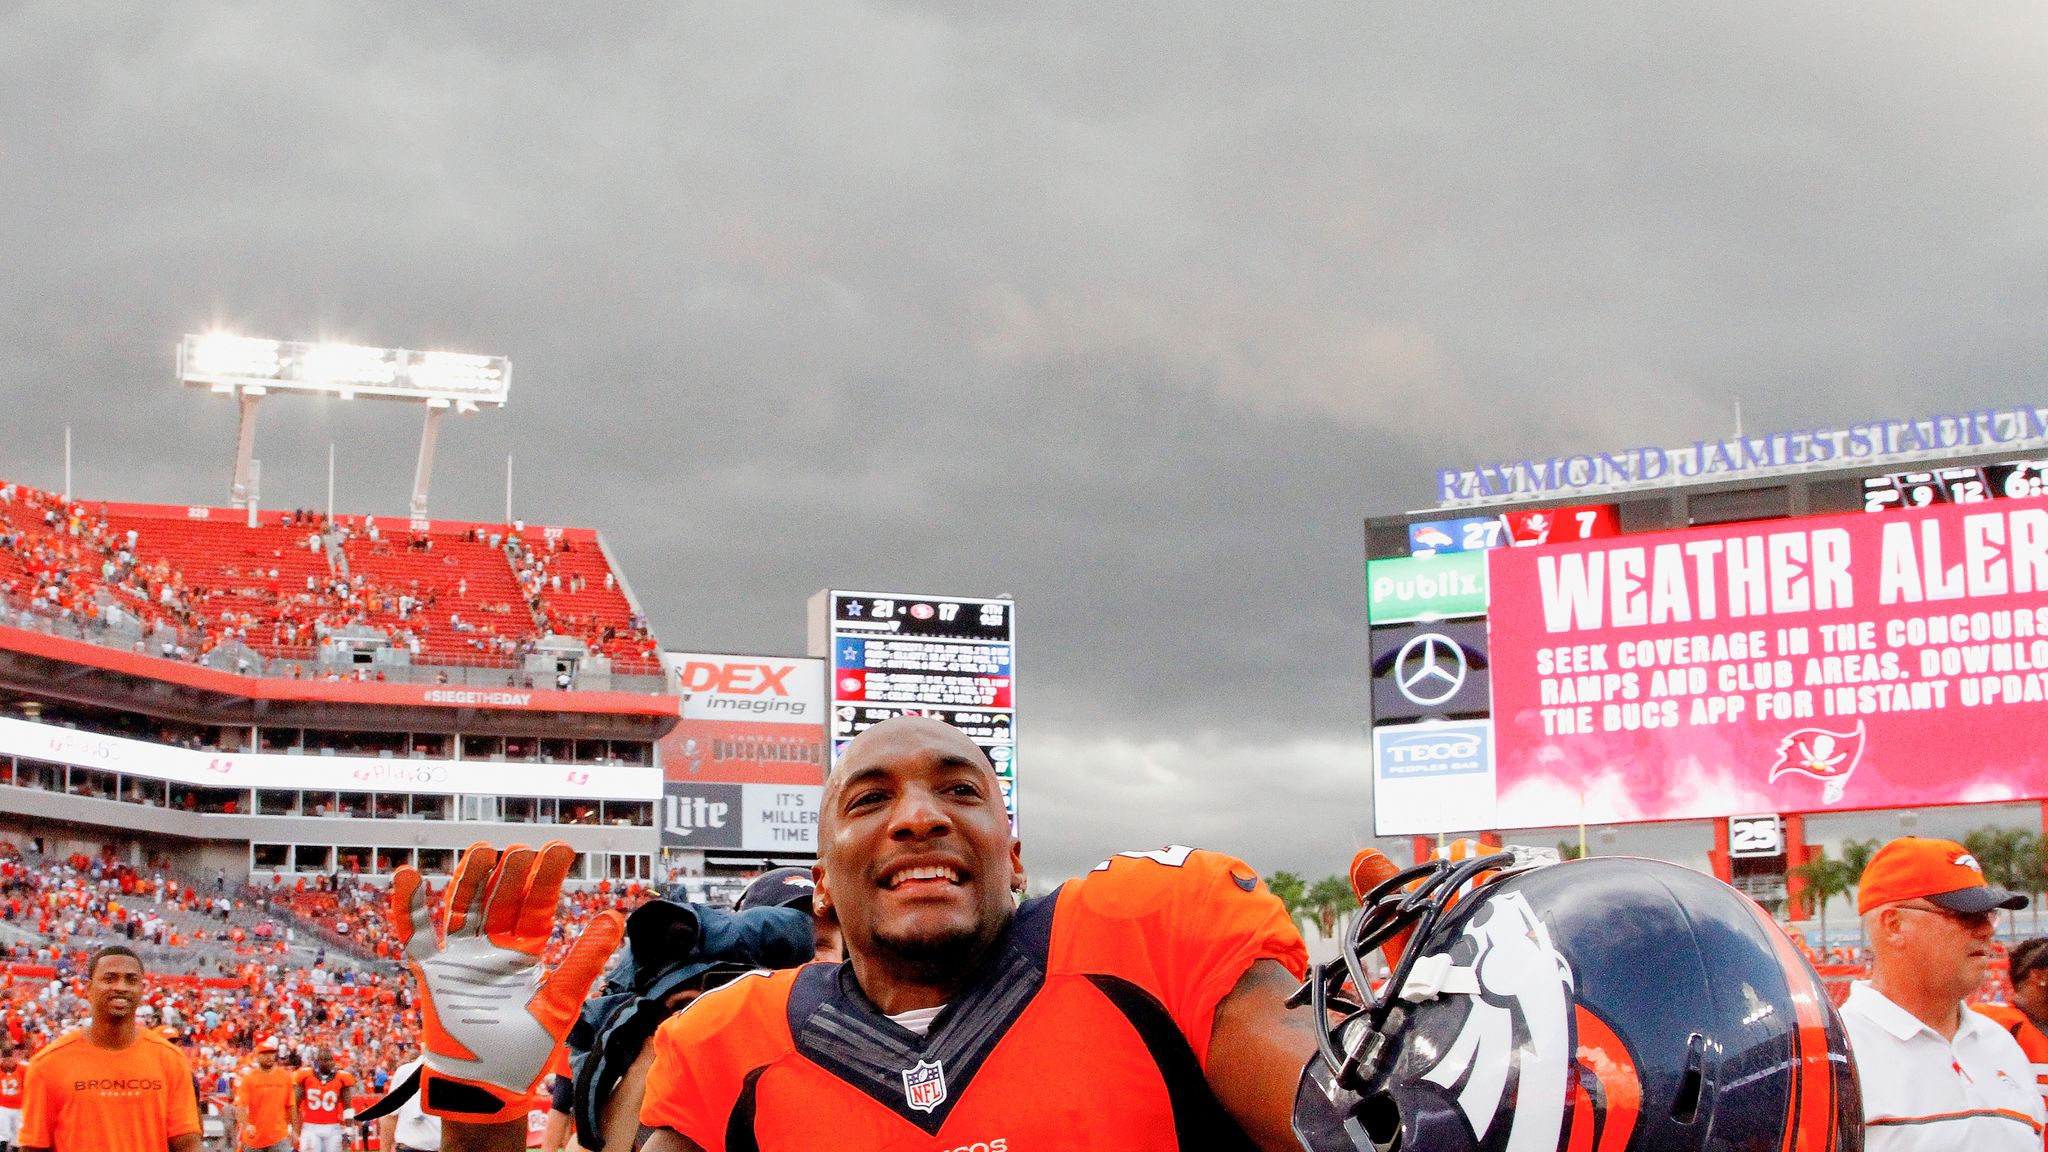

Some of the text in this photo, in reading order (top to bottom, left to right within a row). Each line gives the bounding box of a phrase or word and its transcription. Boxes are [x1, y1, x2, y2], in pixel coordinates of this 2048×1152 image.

[1436, 446, 1669, 500] RAYMOND
[1678, 425, 1835, 476] JAMES
[1913, 486, 1933, 507] 9
[1951, 481, 1984, 504] 12
[1462, 519, 1502, 550] 27
[1575, 511, 1597, 539] 7
[1537, 508, 2048, 633] WEATHER ALER
[871, 600, 959, 621] 21 17
[1537, 607, 2048, 676] SEEK COVERAGE IN THE CONCOURS
[681, 661, 797, 696] DEX
[1540, 640, 2048, 705] RAMPS AND CLUB AREAS. DOWNLO
[424, 690, 531, 706] #SIEGETHEDAY
[706, 695, 807, 715] imaging
[1540, 672, 2048, 736] THE BUCS APP FOR INSTANT UPDAT
[1386, 741, 1478, 763] TECO
[776, 793, 804, 806] IT'S
[663, 795, 728, 836] Lite
[762, 810, 818, 824] MILLER
[773, 828, 809, 841] TIME
[1733, 820, 1777, 850] 25
[75, 1079, 162, 1091] BRONCOS
[912, 1081, 940, 1104] NFL
[307, 1088, 337, 1111] 50
